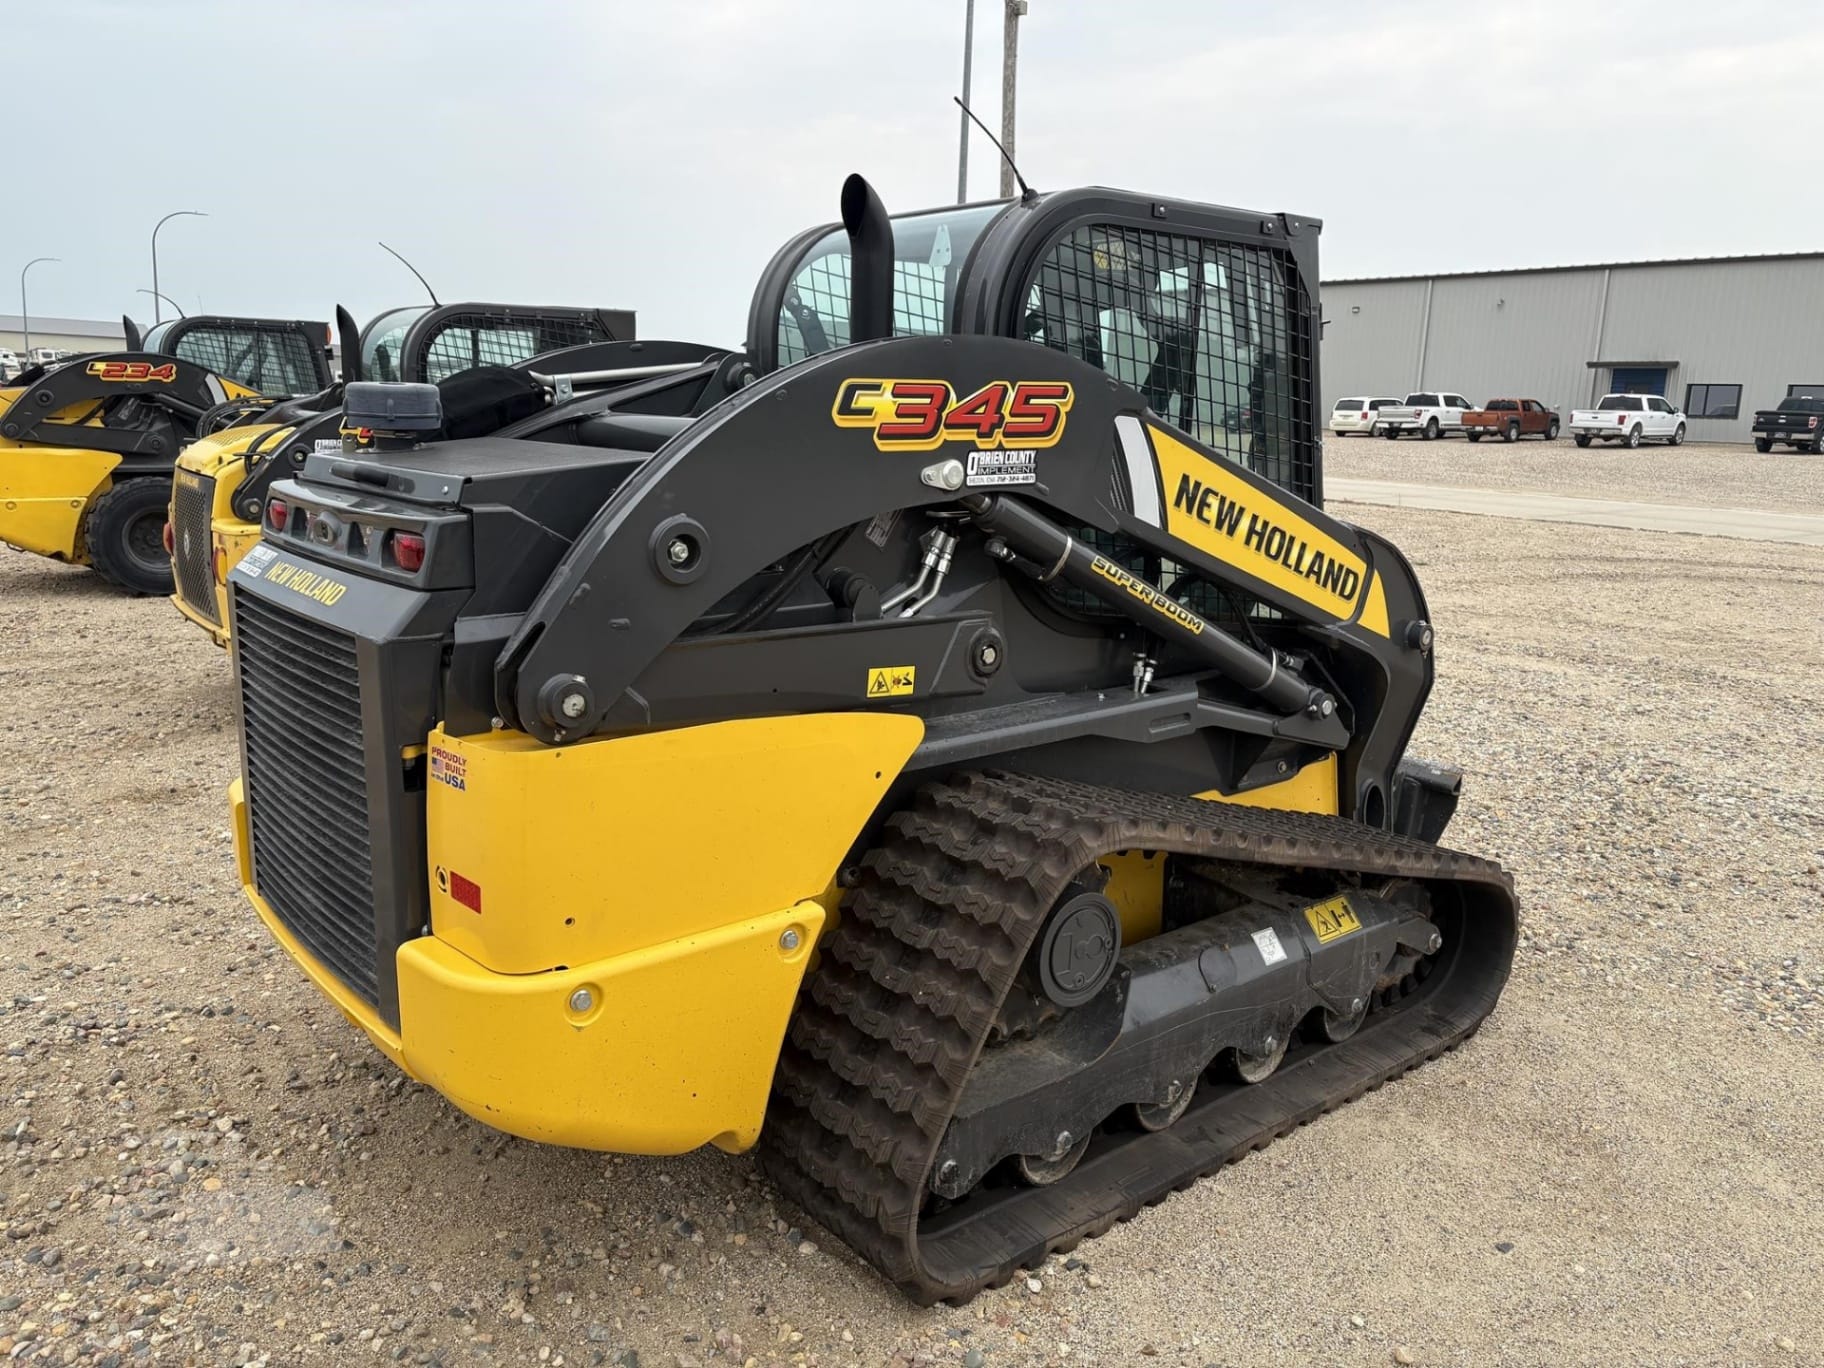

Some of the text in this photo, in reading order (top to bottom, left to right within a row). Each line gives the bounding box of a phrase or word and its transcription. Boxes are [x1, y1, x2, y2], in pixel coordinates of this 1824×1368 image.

[86, 361, 176, 381] L234
[833, 379, 1072, 448] C345
[966, 450, 1036, 475] O'BRIEN COUNTY
[977, 465, 1036, 475] IMPLEMENT
[1174, 472, 1360, 601] NEW HOLLAND
[264, 561, 299, 585] NEW
[285, 568, 347, 607] HOLLAND
[431, 746, 467, 767] PROUDLY
[445, 762, 467, 777] BUILT
[445, 772, 466, 791] USA
